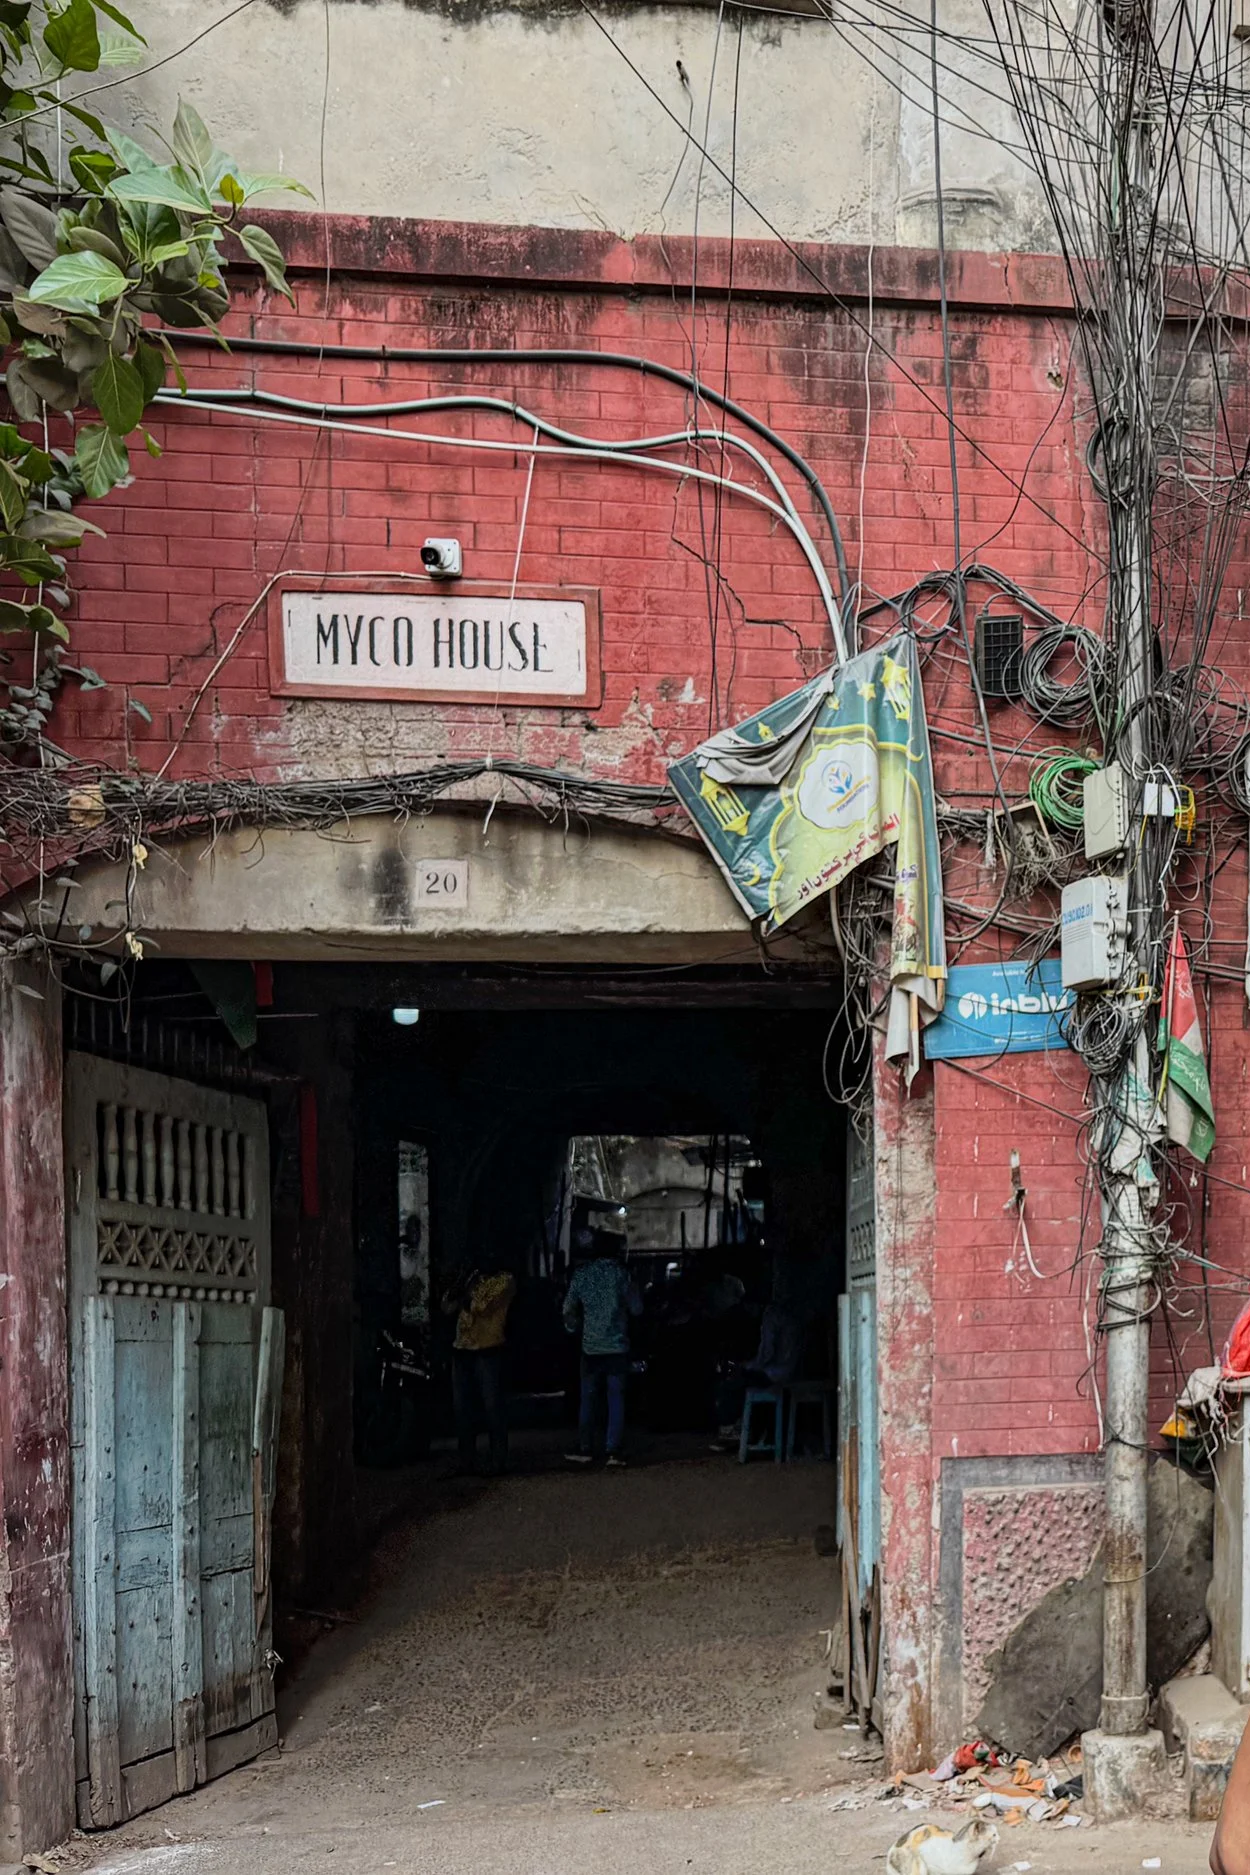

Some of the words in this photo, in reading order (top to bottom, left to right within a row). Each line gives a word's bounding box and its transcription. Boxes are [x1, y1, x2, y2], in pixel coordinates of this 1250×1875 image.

[315, 613, 414, 666] MYCO
[433, 617, 554, 673] HOUSE
[425, 871, 458, 895] 20
